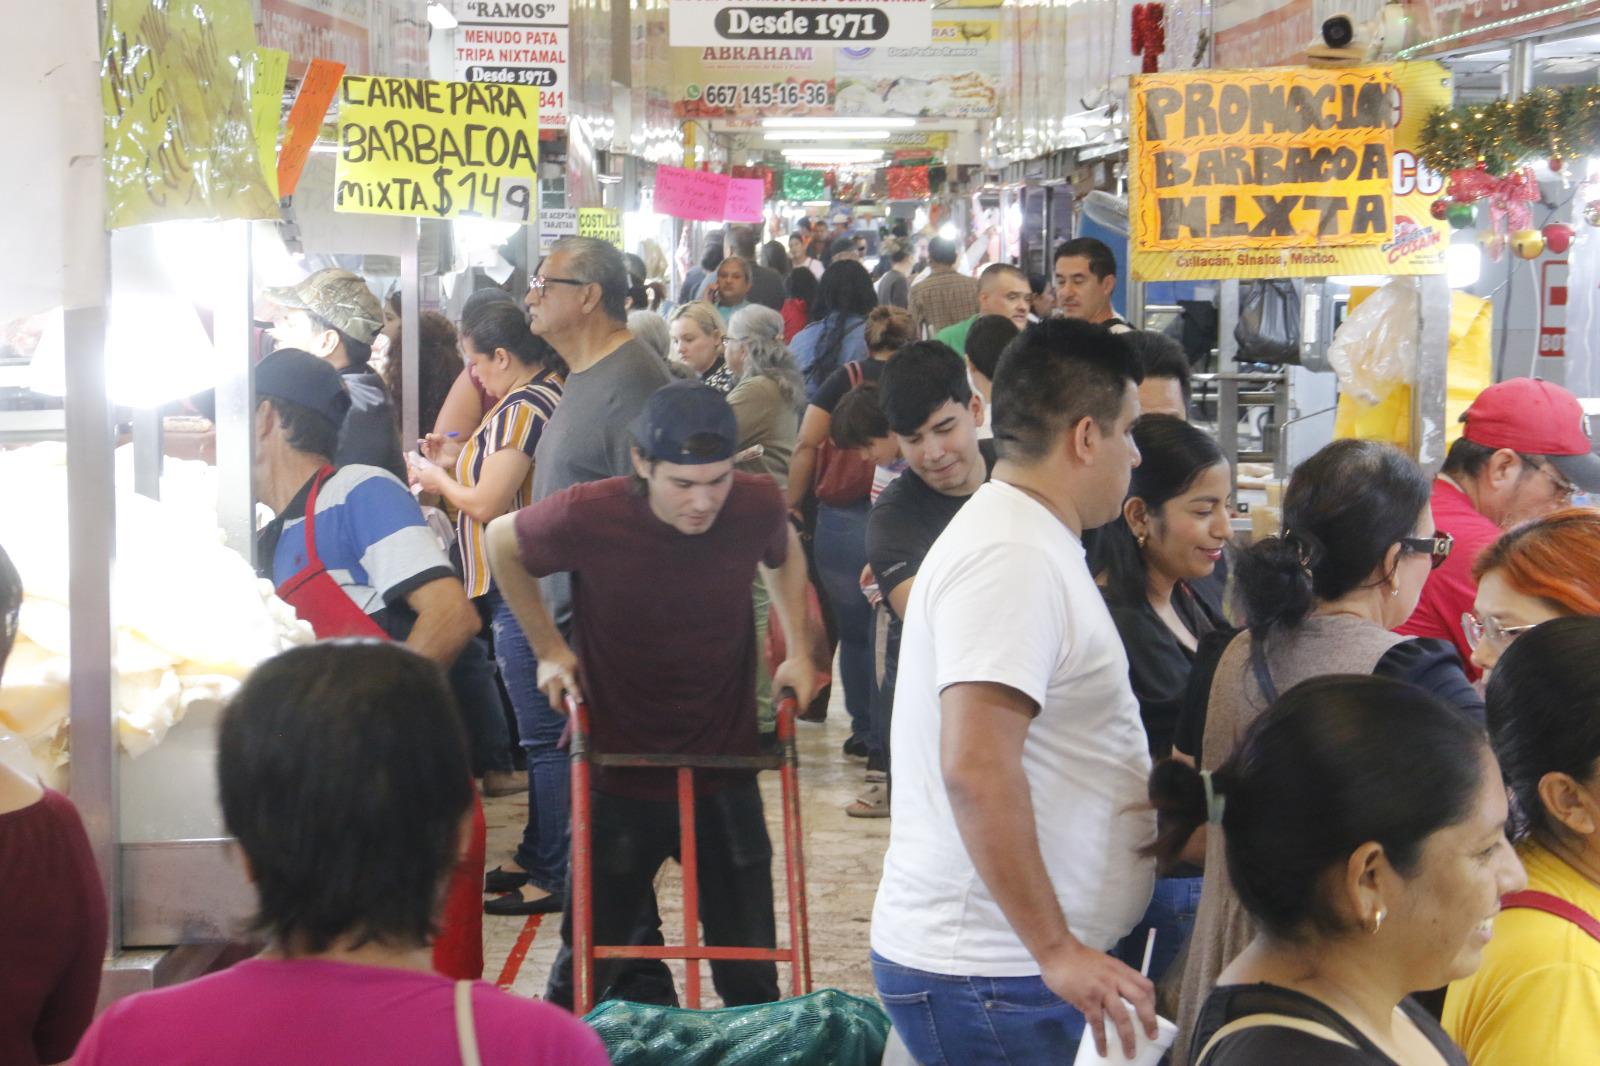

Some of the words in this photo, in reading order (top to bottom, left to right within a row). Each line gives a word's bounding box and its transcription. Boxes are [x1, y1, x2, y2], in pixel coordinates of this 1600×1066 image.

[728, 9, 809, 34] Desde
[815, 14, 876, 38] 1971
[465, 30, 522, 44] MENUDO
[526, 32, 557, 45] PATA
[457, 48, 495, 61] TRIPA
[500, 49, 566, 63] NIXTAMAL
[703, 47, 813, 60] ABRAHAM
[472, 66, 515, 82] Desde
[517, 70, 551, 83] 1971
[343, 76, 445, 113] CARNE
[446, 82, 527, 119] PARA
[706, 85, 737, 105] 667
[742, 86, 826, 105] 145-16-36
[342, 119, 537, 172] BARBACOA
[1154, 143, 1388, 188] BARBACOA
[540, 211, 548, 219] SE
[550, 211, 576, 219] ACEPTAN
[1157, 194, 1388, 241] MIXTA
